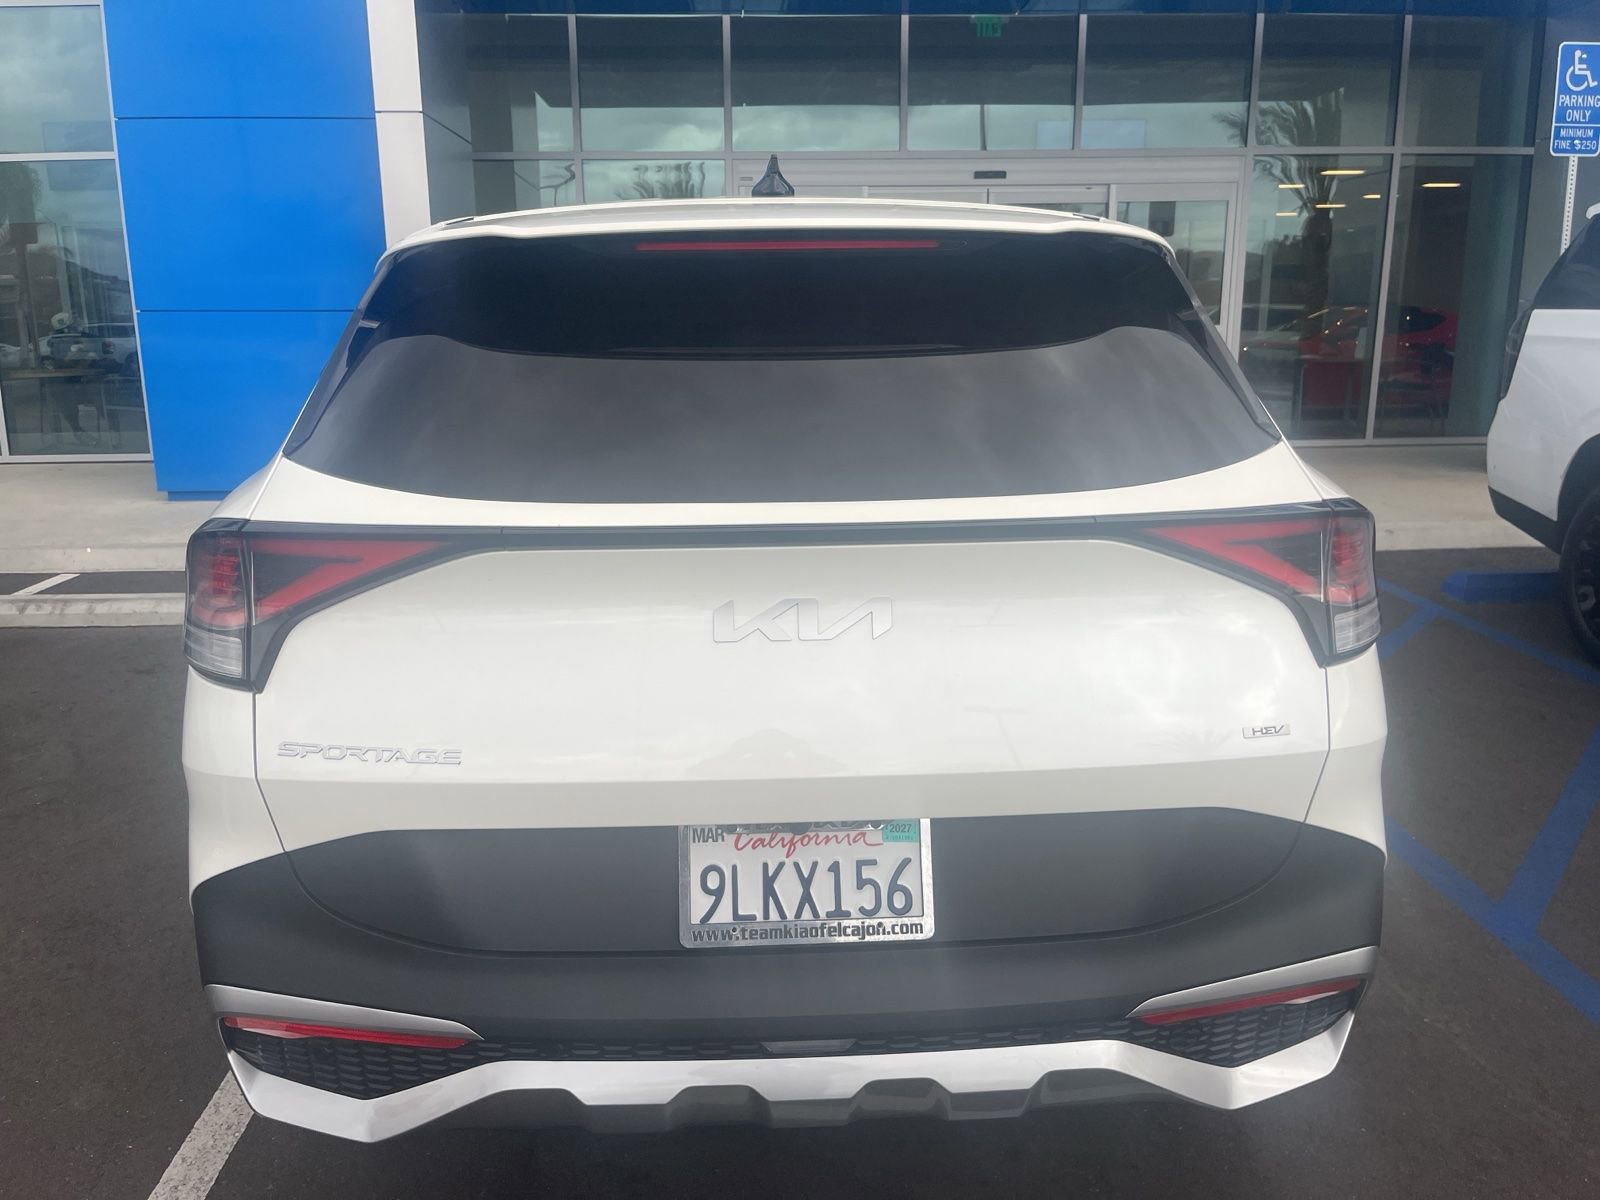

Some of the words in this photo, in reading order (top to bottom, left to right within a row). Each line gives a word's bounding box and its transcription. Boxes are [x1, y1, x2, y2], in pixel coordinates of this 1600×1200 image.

[1558, 94, 1600, 108] PARKING
[1566, 109, 1591, 122] ONLY
[1560, 127, 1594, 138] MINIMUM
[1554, 139, 1571, 150] FINE
[1573, 139, 1597, 151] $250
[713, 597, 893, 643] KIA
[1252, 725, 1285, 737] HEV
[277, 741, 463, 766] SPORTAGE
[692, 827, 725, 844] MAR
[889, 823, 912, 833] 2027
[733, 830, 884, 859] California
[699, 857, 914, 925] 9LKX156
[691, 921, 924, 943] www.teamkiaofelcajon.com
